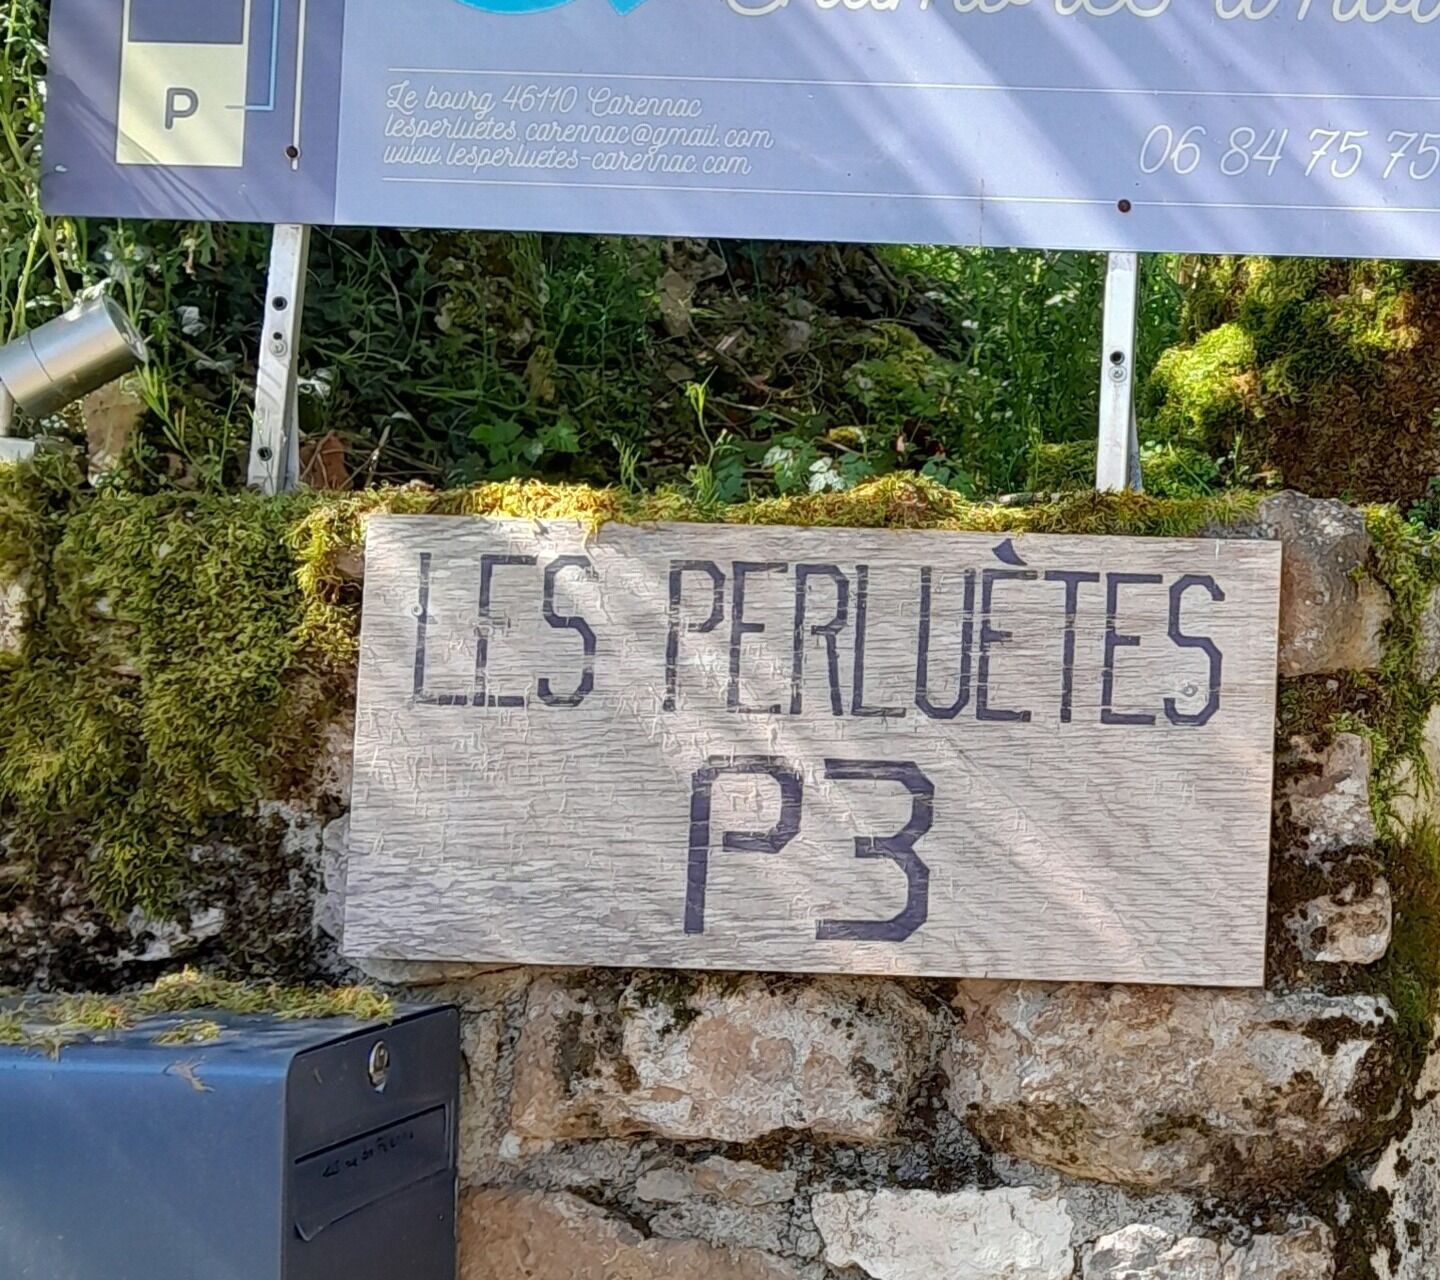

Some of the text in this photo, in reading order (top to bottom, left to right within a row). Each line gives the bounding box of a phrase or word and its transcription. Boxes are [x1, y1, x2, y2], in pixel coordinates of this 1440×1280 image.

[163, 87, 200, 129] P
[386, 79, 704, 119] Le bourg 46110 Carennac
[384, 114, 774, 154] lesperluetes.carennac@gmail.com
[1139, 123, 1208, 175] 06
[1219, 127, 1288, 177] 84
[1304, 128, 1370, 179] 75
[383, 143, 752, 176] www.lesperluetes-carennac.com
[412, 537, 1227, 727] LES PERLUÈTES
[682, 755, 936, 942] P3
